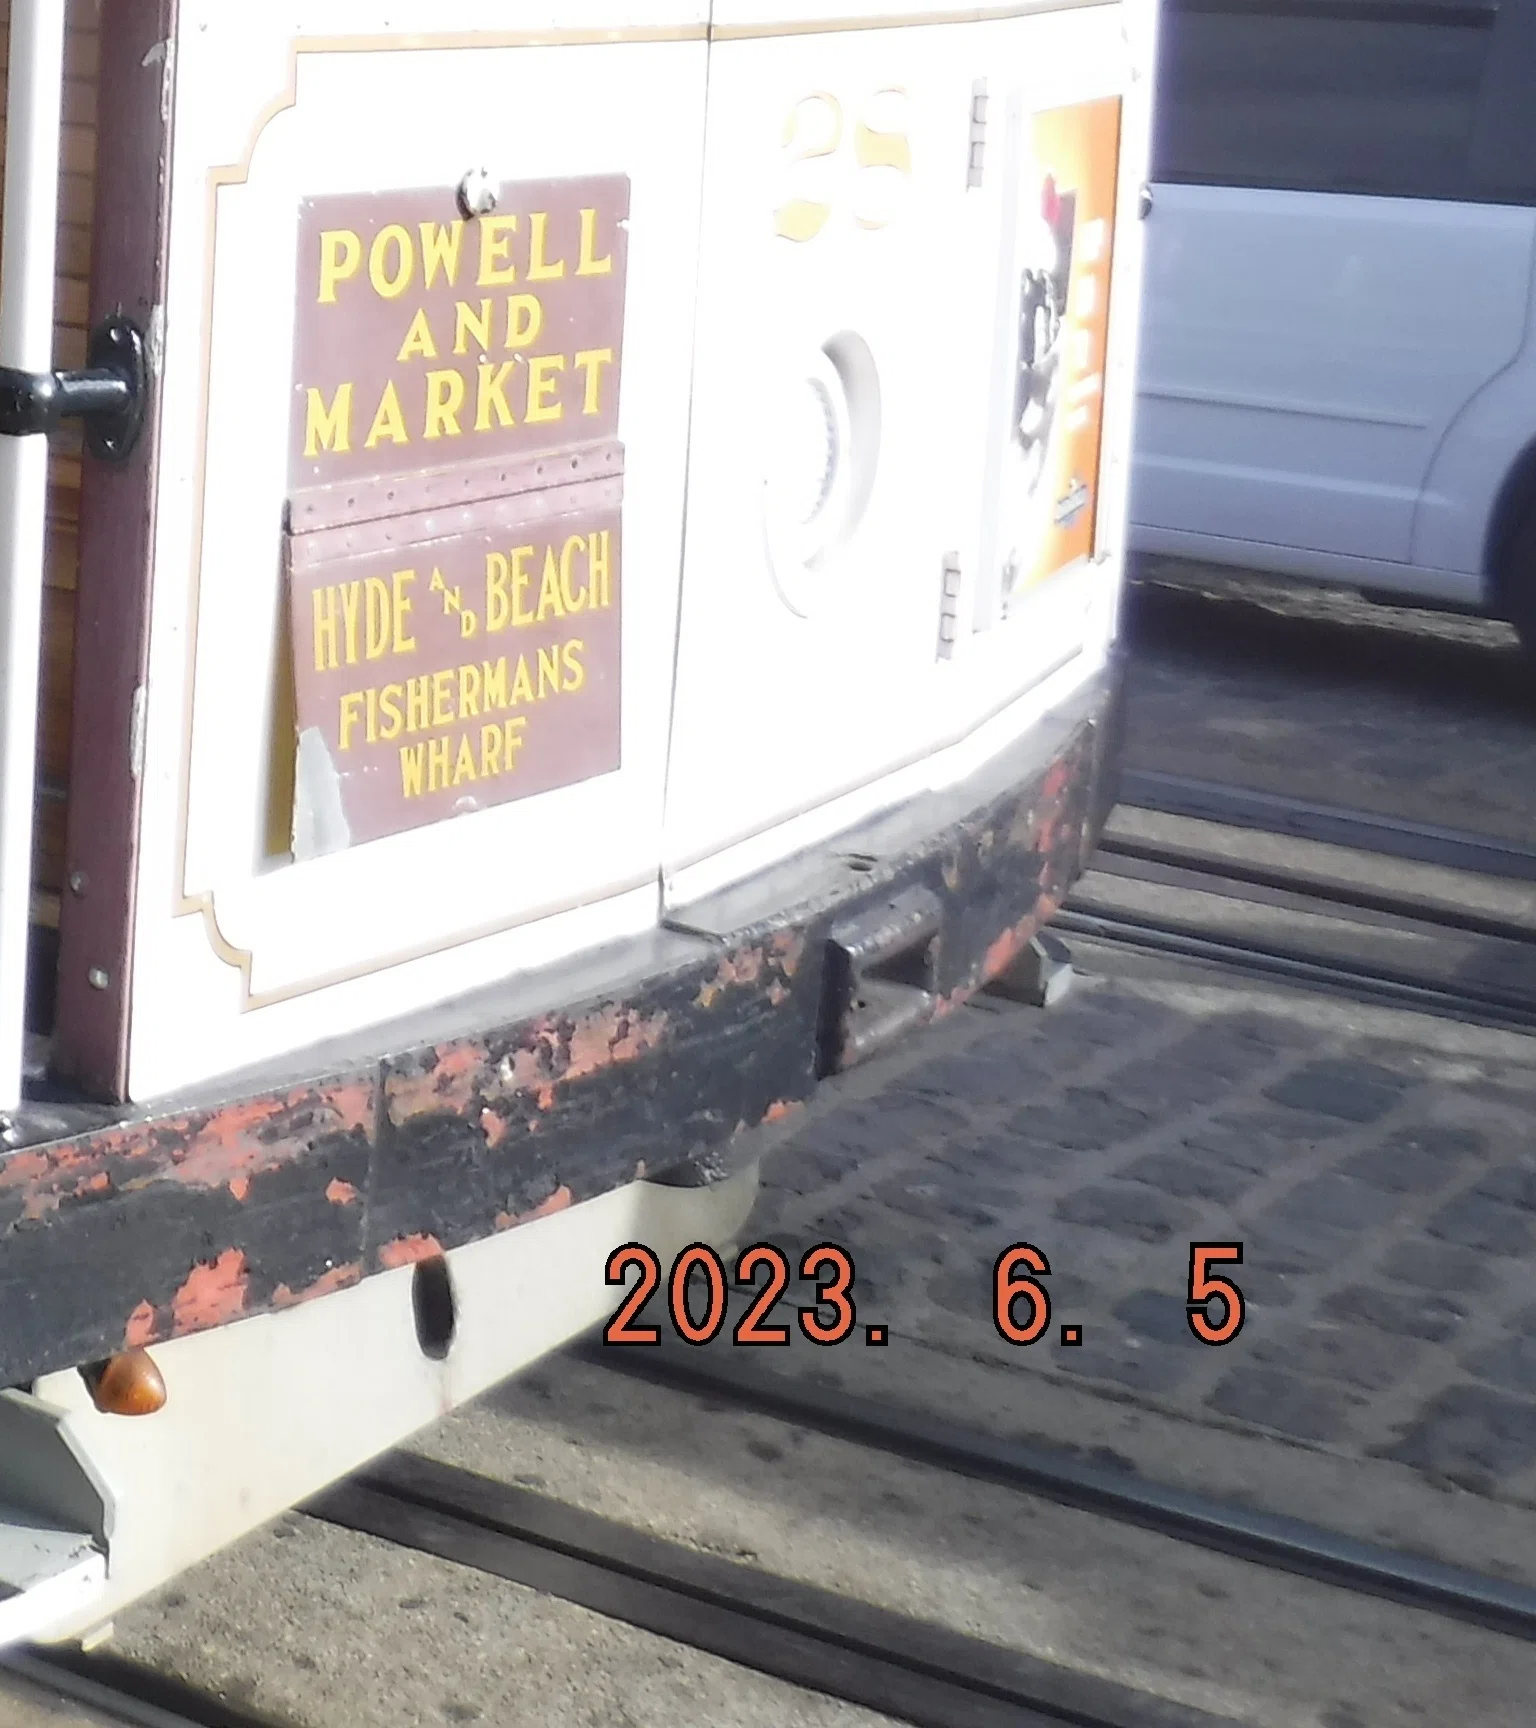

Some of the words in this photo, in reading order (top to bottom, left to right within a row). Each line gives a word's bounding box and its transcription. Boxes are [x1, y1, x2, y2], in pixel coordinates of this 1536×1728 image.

[316, 208, 614, 303] POWELL
[397, 293, 543, 362] AND
[303, 348, 613, 458] MARKET
[312, 569, 416, 672] HYDE
[428, 565, 478, 640] AND
[484, 530, 612, 633] BEACH
[338, 639, 585, 750] FISHERMANS
[399, 715, 528, 799] WHARF
